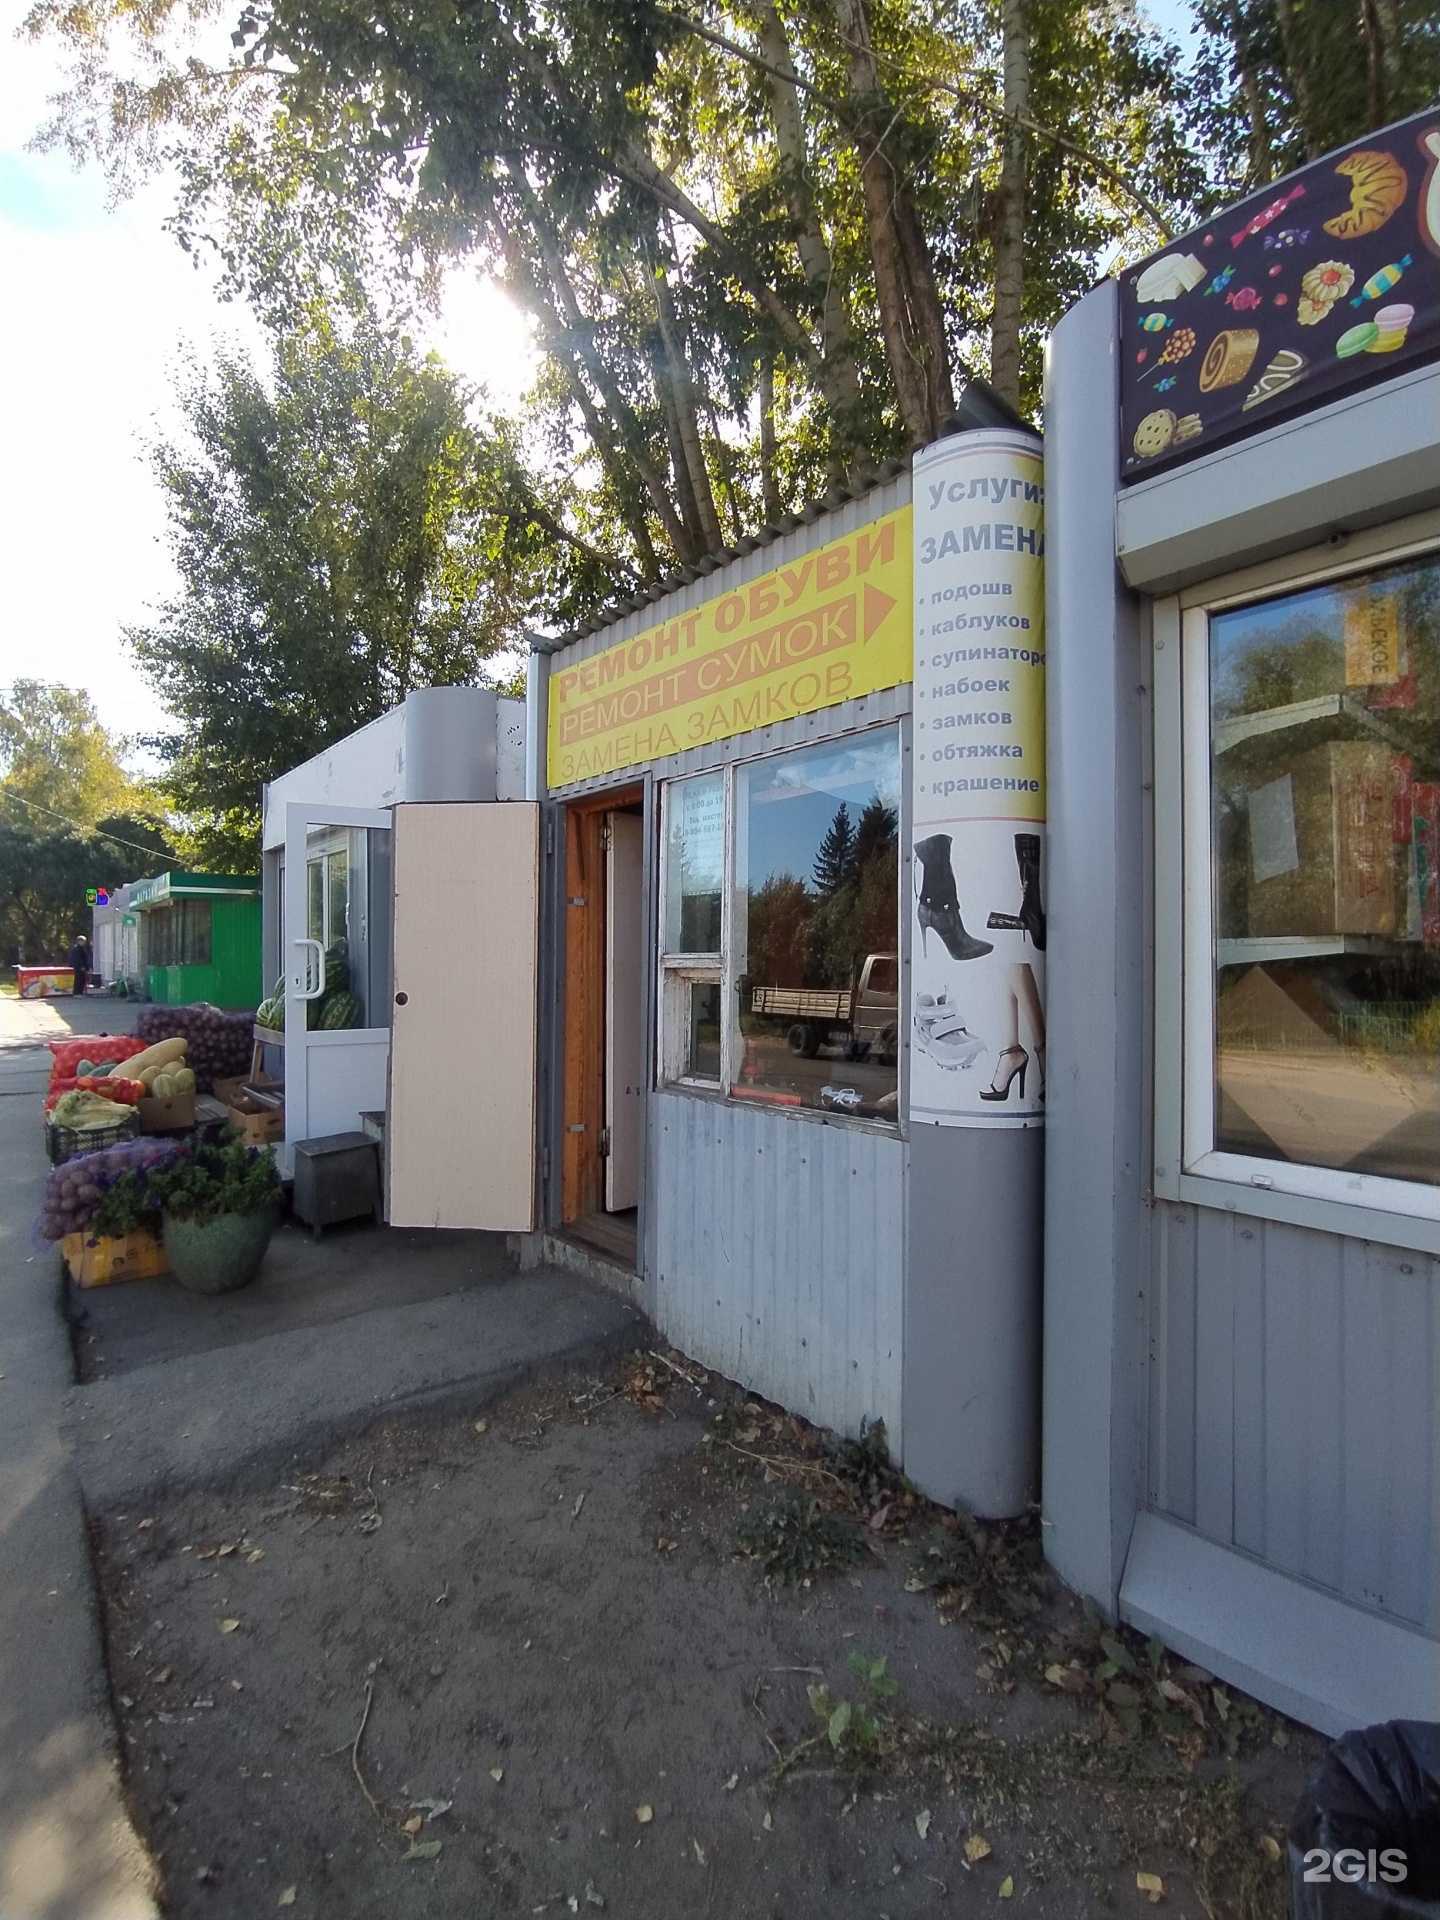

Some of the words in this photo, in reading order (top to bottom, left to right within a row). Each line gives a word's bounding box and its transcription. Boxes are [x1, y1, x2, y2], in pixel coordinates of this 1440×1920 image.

[930, 581, 1013, 605] подошв
[559, 612, 703, 703] РЕМОНТ
[714, 520, 896, 634] ОБУВИ
[930, 612, 1031, 637] каблуков
[562, 670, 687, 742] РЕМОНТ
[697, 604, 849, 691] СУМОК
[930, 675, 1010, 700] набоек
[561, 722, 677, 780] ЗАМЕНА
[687, 661, 854, 741] ЗАМКОВ
[930, 709, 1013, 731] замков
[930, 741, 1024, 763] обтяжка
[930, 777, 1041, 799] крашение
